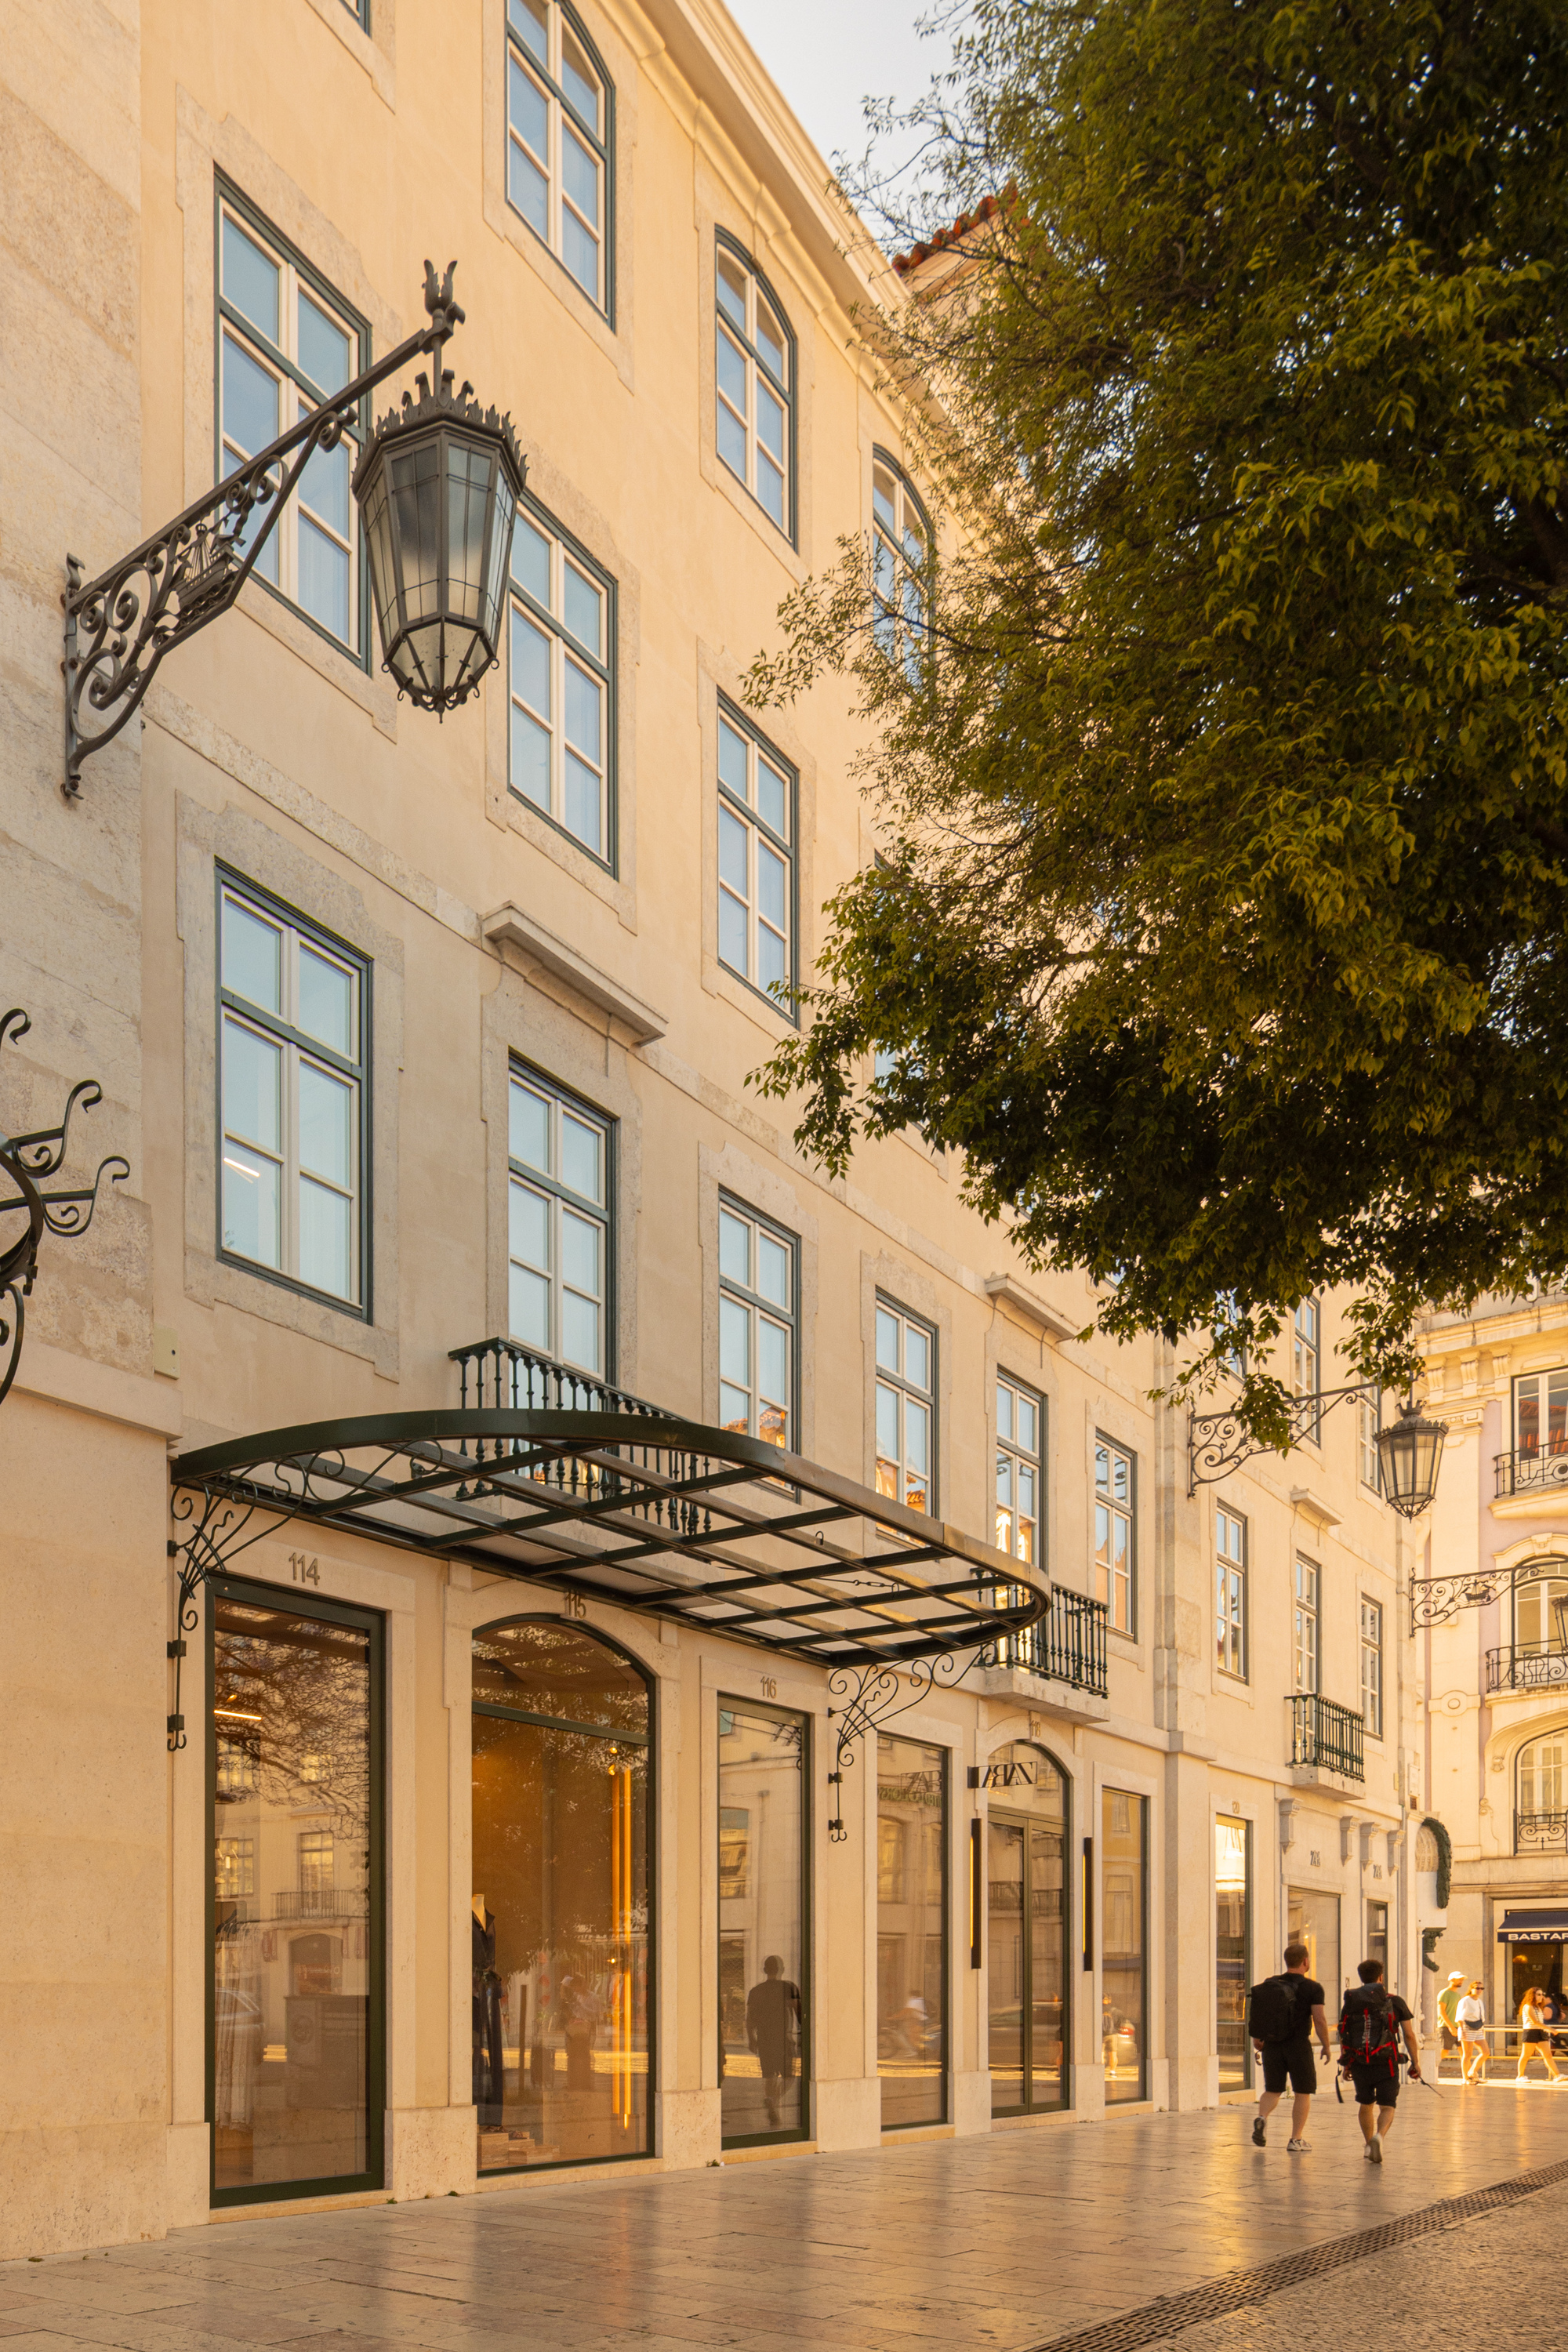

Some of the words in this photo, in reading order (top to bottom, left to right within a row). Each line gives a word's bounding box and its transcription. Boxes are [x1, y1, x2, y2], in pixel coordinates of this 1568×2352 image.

[289, 1552, 321, 1586] 114
[564, 1591, 586, 1620] 115
[760, 1675, 777, 1699] 116
[1029, 1720, 1041, 1738] 118
